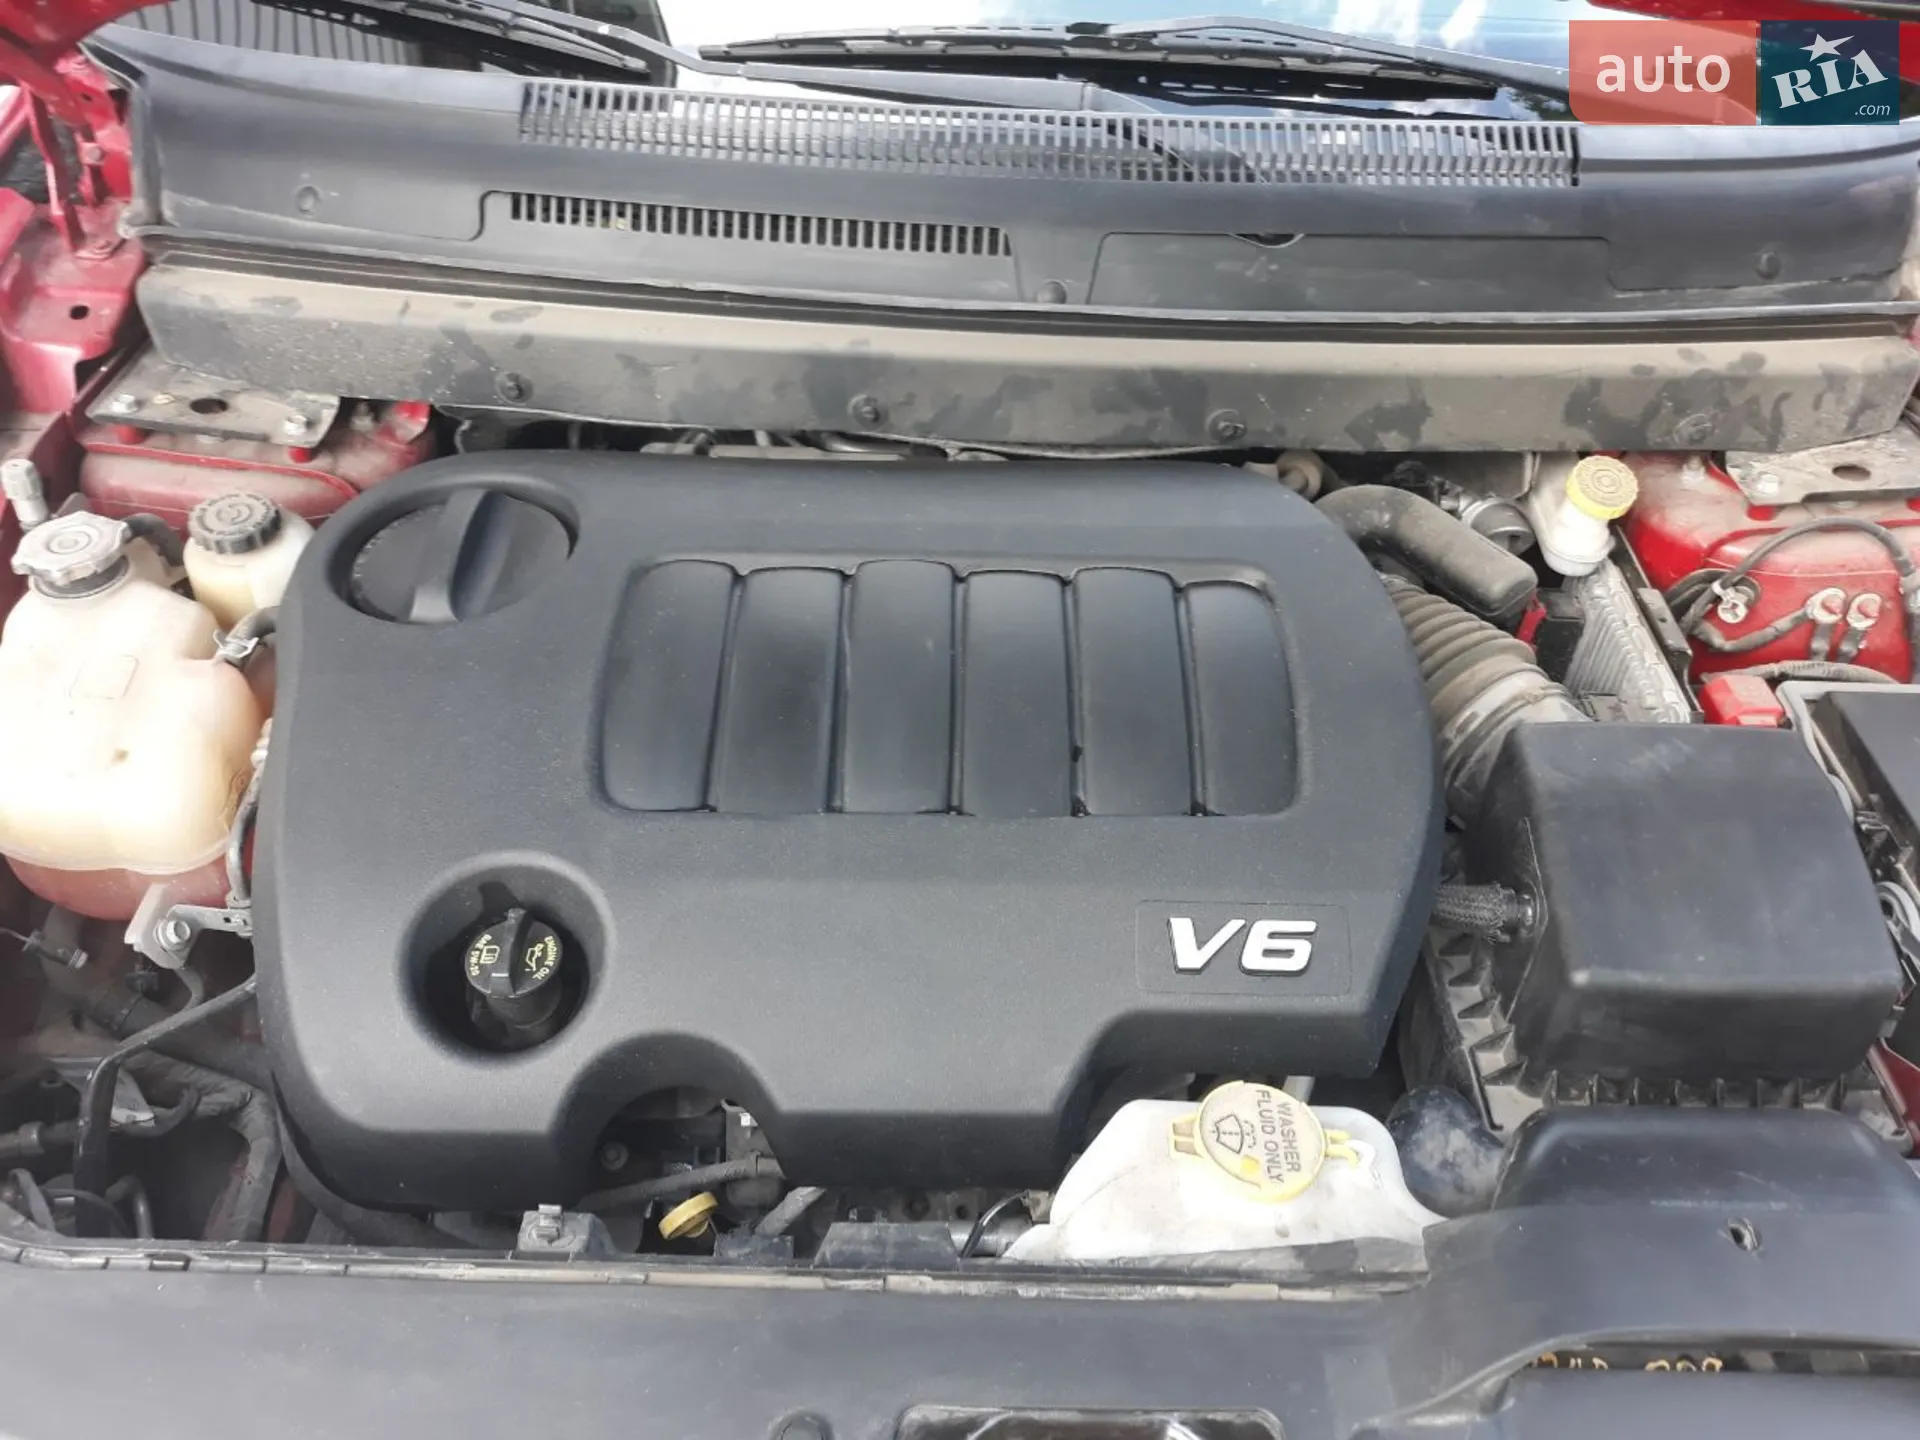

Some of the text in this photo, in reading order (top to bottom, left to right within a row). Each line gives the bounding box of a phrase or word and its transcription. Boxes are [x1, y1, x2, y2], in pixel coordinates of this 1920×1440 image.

[532, 935, 558, 980] ENGINE OIL
[1167, 917, 1318, 976] V6
[1256, 1089, 1285, 1184] FLUID ONLY
[1276, 1101, 1301, 1173] WASHER
